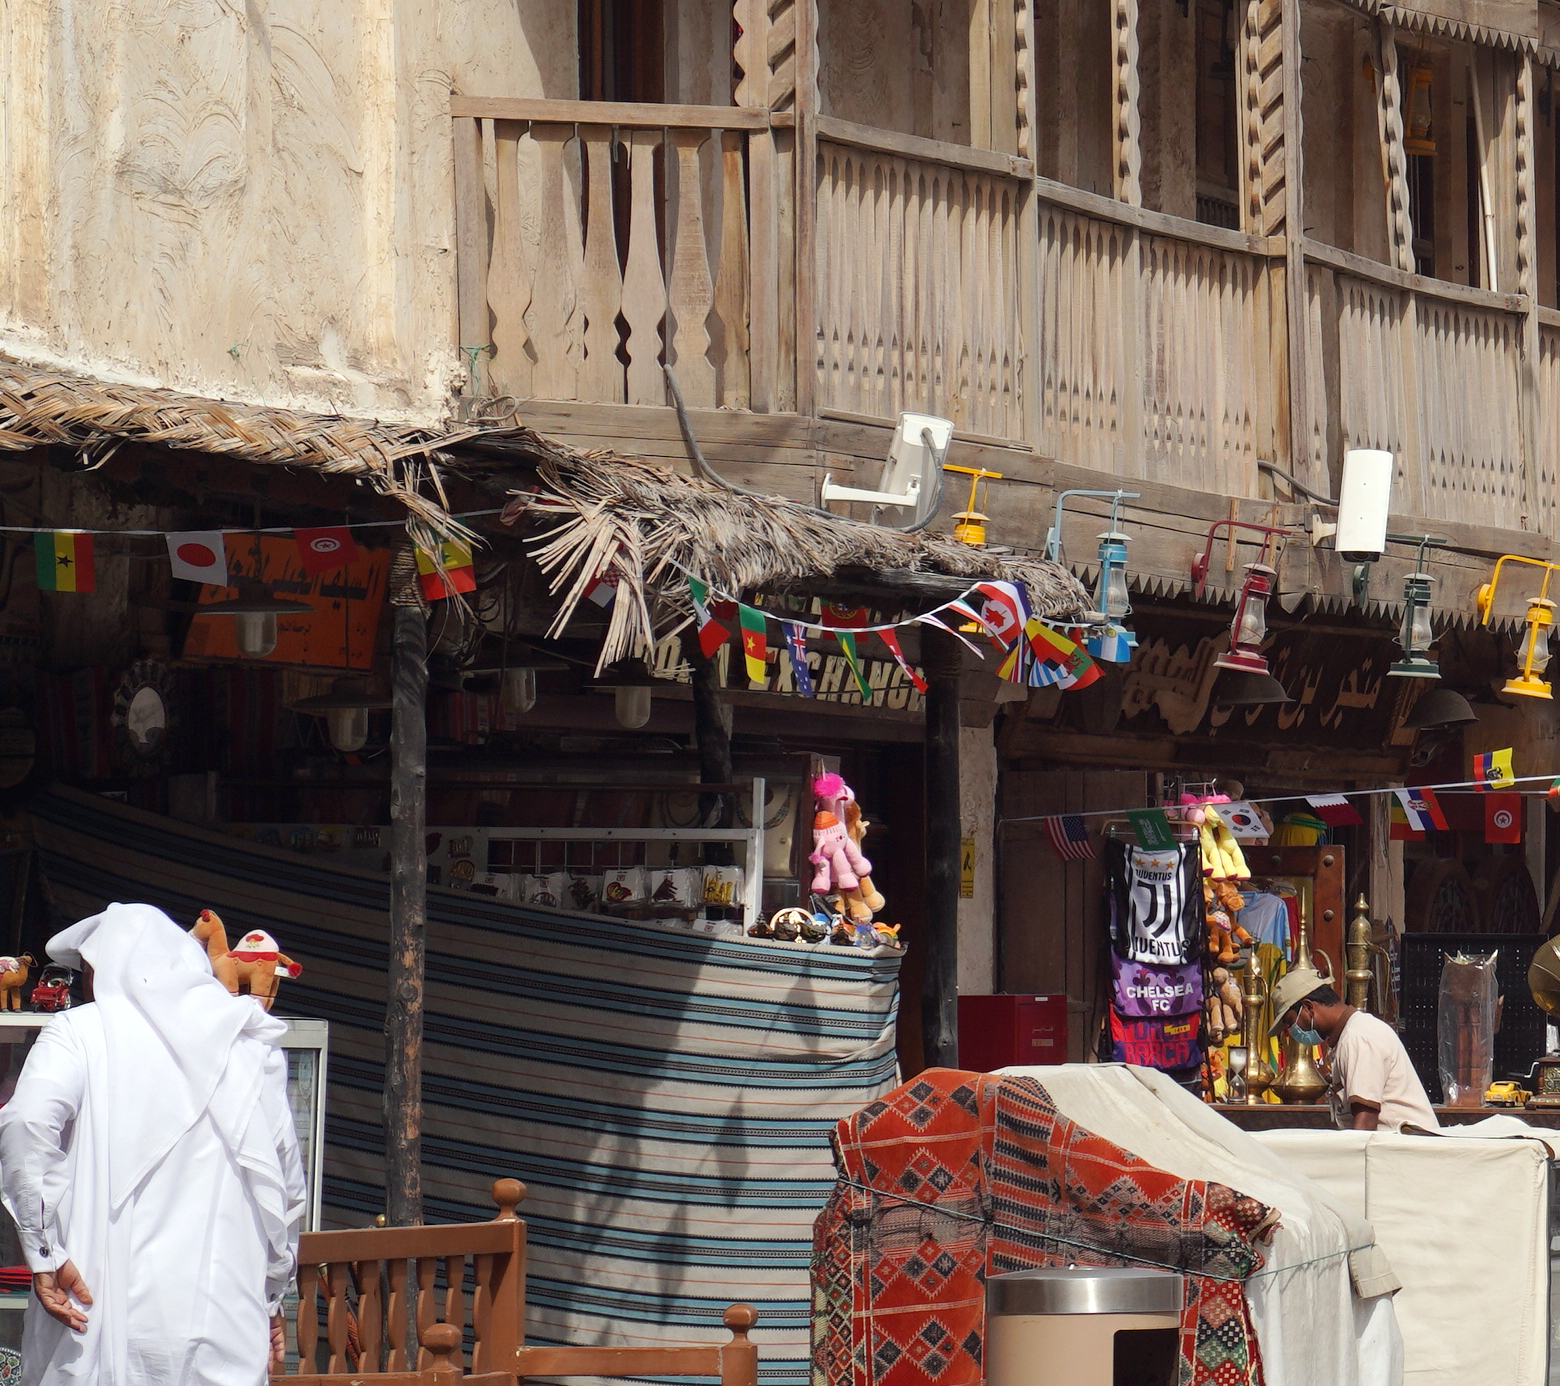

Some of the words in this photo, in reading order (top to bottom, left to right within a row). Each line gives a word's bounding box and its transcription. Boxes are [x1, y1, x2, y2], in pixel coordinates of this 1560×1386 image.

[1135, 868, 1172, 881] JUVENTUS
[1127, 936, 1190, 958] JUVENTUS
[1126, 982, 1194, 999] CHELSEA
[1152, 999, 1171, 1012] FC
